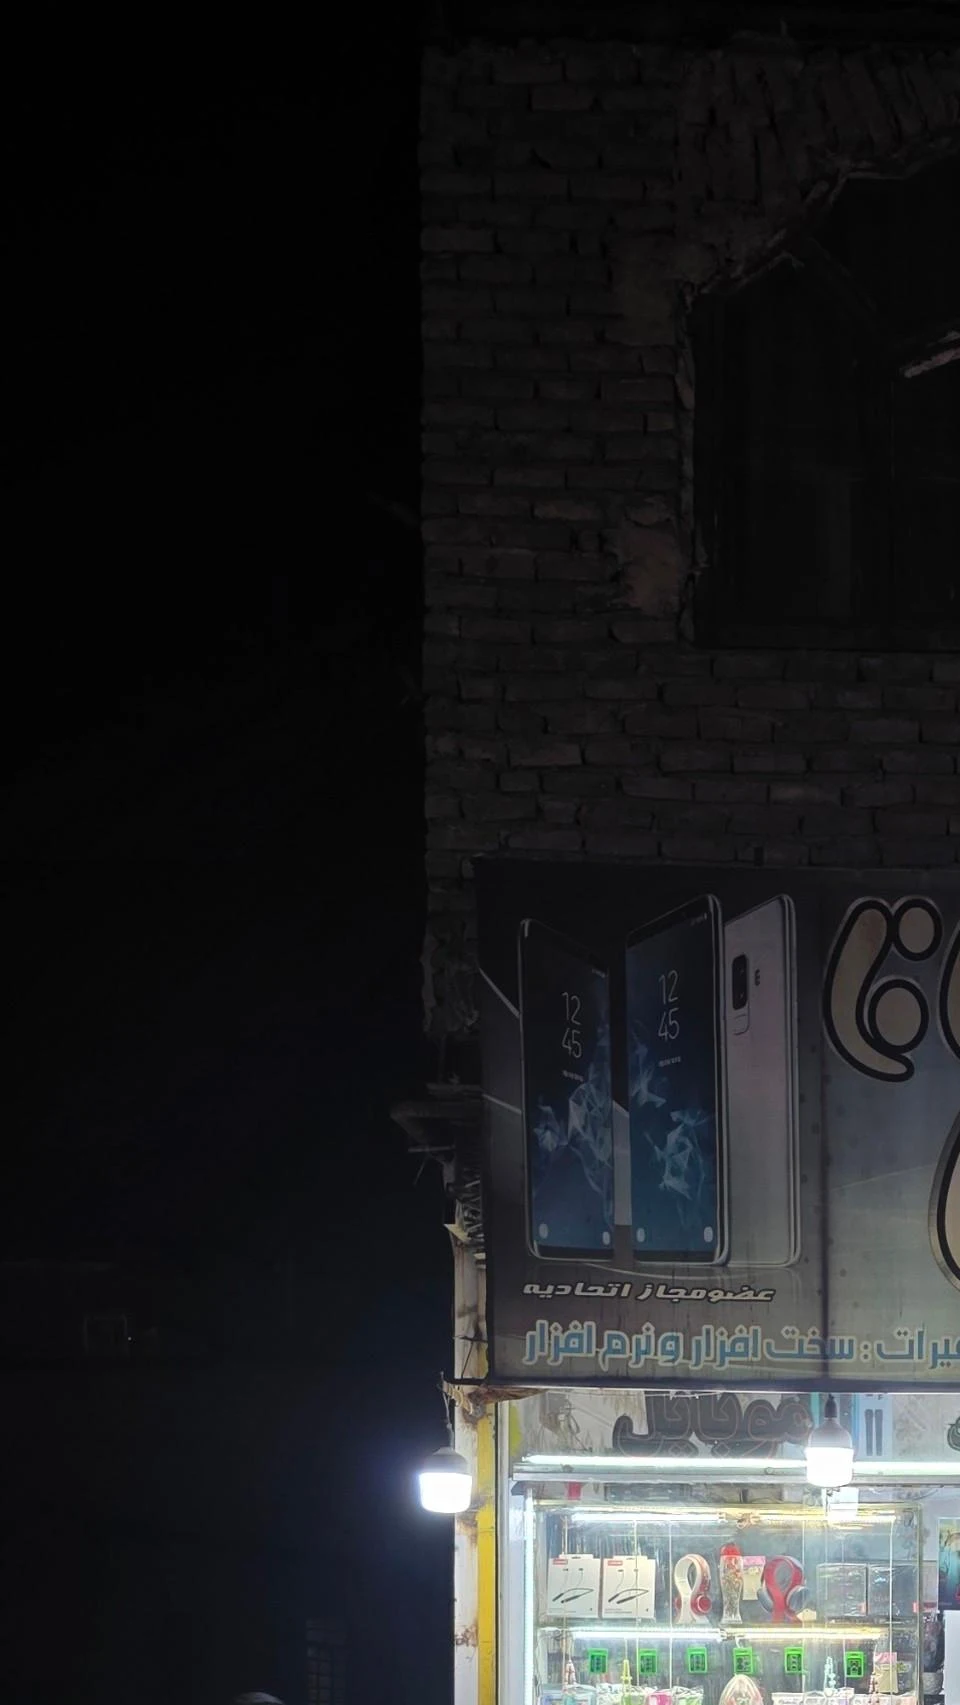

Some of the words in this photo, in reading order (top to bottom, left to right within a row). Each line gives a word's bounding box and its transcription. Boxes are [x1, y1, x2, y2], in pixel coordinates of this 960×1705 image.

[658, 970, 680, 1005] 12
[561, 991, 582, 1025] 12
[658, 1007, 680, 1042] 45
[561, 1029, 583, 1059] 45
[522, 1281, 632, 1299] اتحادیه
[522, 1319, 596, 1366] افزار
[689, 1324, 762, 1369] افزار
[763, 1325, 856, 1362] سخت
